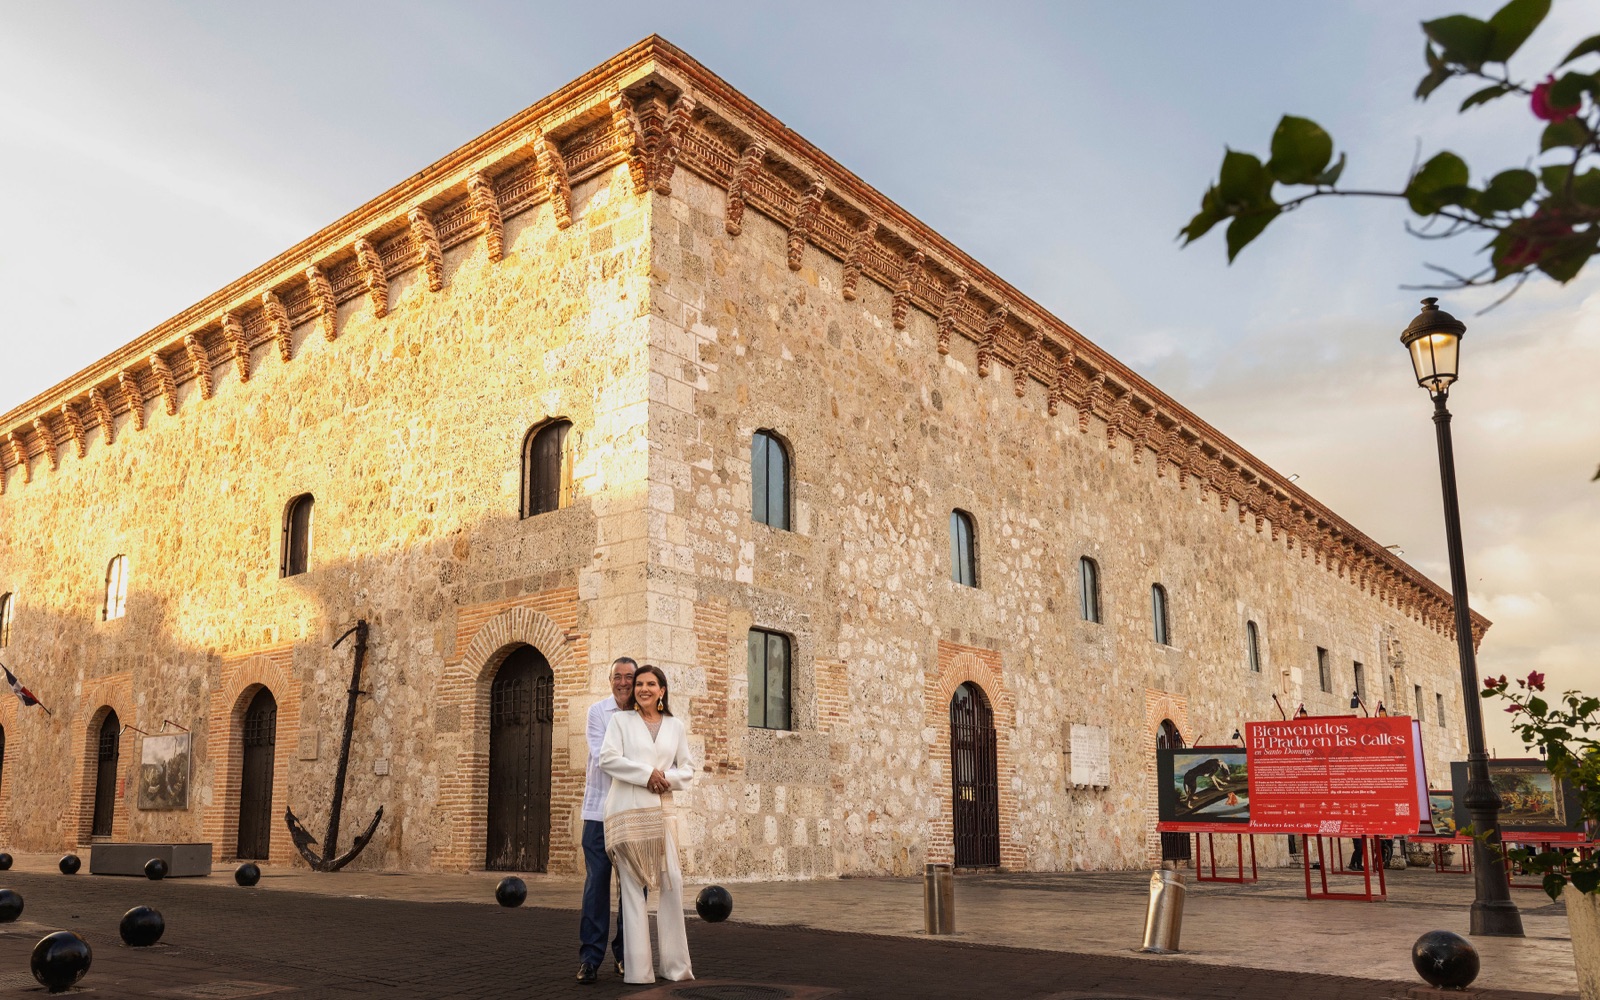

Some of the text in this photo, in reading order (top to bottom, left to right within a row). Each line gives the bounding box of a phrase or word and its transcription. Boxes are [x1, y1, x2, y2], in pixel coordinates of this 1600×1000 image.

[1253, 723, 1348, 737] Bienvenidos
[1253, 733, 1405, 749] El Prado en las Calles
[1284, 748, 1314, 756] Domingo
